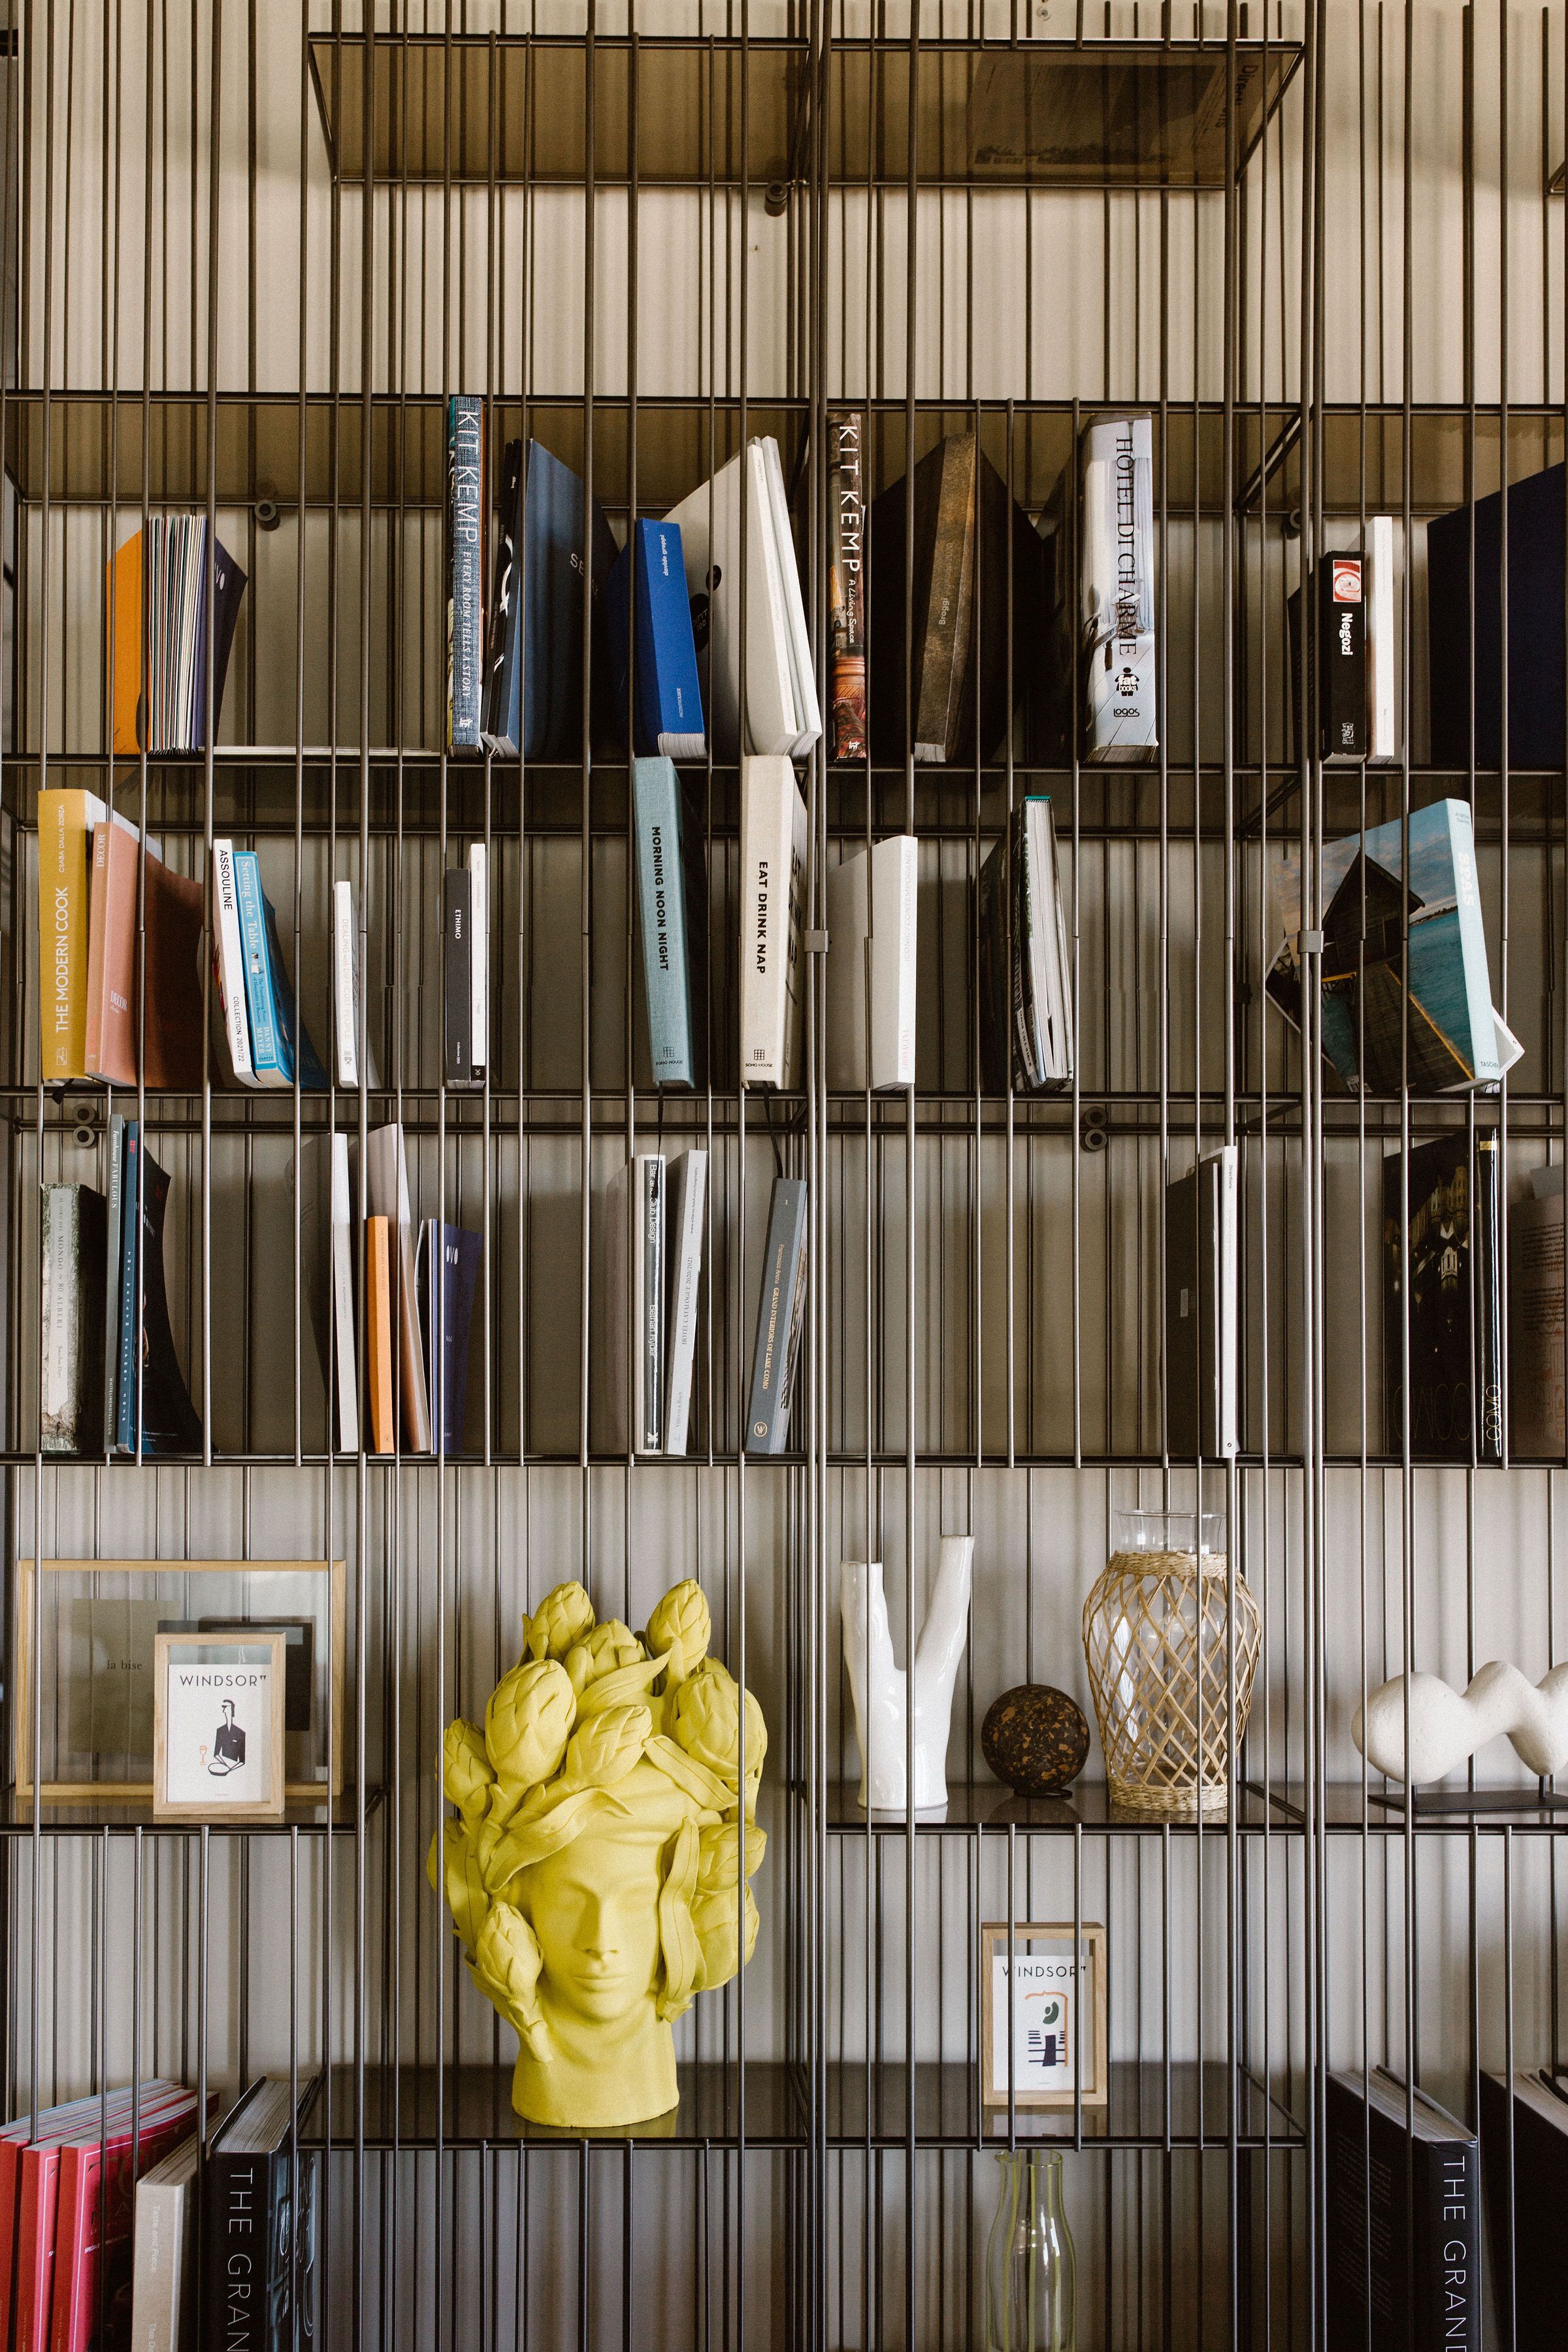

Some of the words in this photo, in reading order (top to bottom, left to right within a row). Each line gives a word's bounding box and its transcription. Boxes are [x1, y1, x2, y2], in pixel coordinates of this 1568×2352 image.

[458, 411, 479, 455] KIT
[839, 425, 858, 476] KIT
[1116, 438, 1135, 514] HOTEL
[457, 466, 478, 543] KEMP
[659, 534, 668, 555] groppi
[840, 490, 860, 572] KEMP
[1117, 523, 1135, 545] DI
[463, 551, 472, 585] EVERY
[462, 587, 472, 619] ROOM
[846, 587, 857, 616] Living
[938, 597, 949, 626] Broggi
[1118, 552, 1137, 656] CHARME
[462, 621, 471, 651] TELLS
[847, 617, 857, 644] Space
[1339, 613, 1353, 656] Negozi
[462, 664, 471, 698] STORY
[1118, 674, 1137, 686] fat
[96, 834, 106, 868] DECOR
[652, 826, 663, 886] MORNING
[220, 849, 233, 910] ASSOULINE
[241, 860, 252, 898] Setting
[759, 861, 768, 889] EAT
[55, 886, 69, 933] COOK
[245, 901, 255, 917] the
[656, 890, 666, 928] NOON
[757, 892, 767, 939] DRINK
[248, 920, 259, 949] Table
[658, 930, 669, 972] NIGHT
[56, 936, 69, 1000] MODERN
[757, 943, 766, 974] NAP
[110, 989, 128, 1011] DECOR
[233, 996, 242, 1035] COLLECTION
[56, 1003, 69, 1034] THE
[256, 1026, 265, 1054] MEYER
[110, 1163, 119, 1209] FABULOUS
[648, 1217, 657, 1244] Design
[446, 1245, 458, 1265] OVO
[775, 1243, 784, 1269] Francesco
[57, 1282, 64, 1292] 80
[772, 1286, 780, 1309] GRAND
[682, 1285, 691, 1324] CATALOGUE
[768, 1309, 777, 1343] INTERIORS
[766, 1343, 774, 1352] OF
[762, 1369, 771, 1390] COMO
[1485, 1384, 1502, 1441] COMO
[106, 1659, 116, 1670] la
[121, 1659, 142, 1670] bise
[229, 2167, 253, 2234] THE
[1443, 2155, 1465, 2221] THE
[152, 2205, 160, 2229] Taste
[151, 2229, 159, 2246] and
[227, 2253, 252, 2352] GRAN
[148, 2323, 157, 2339] The
